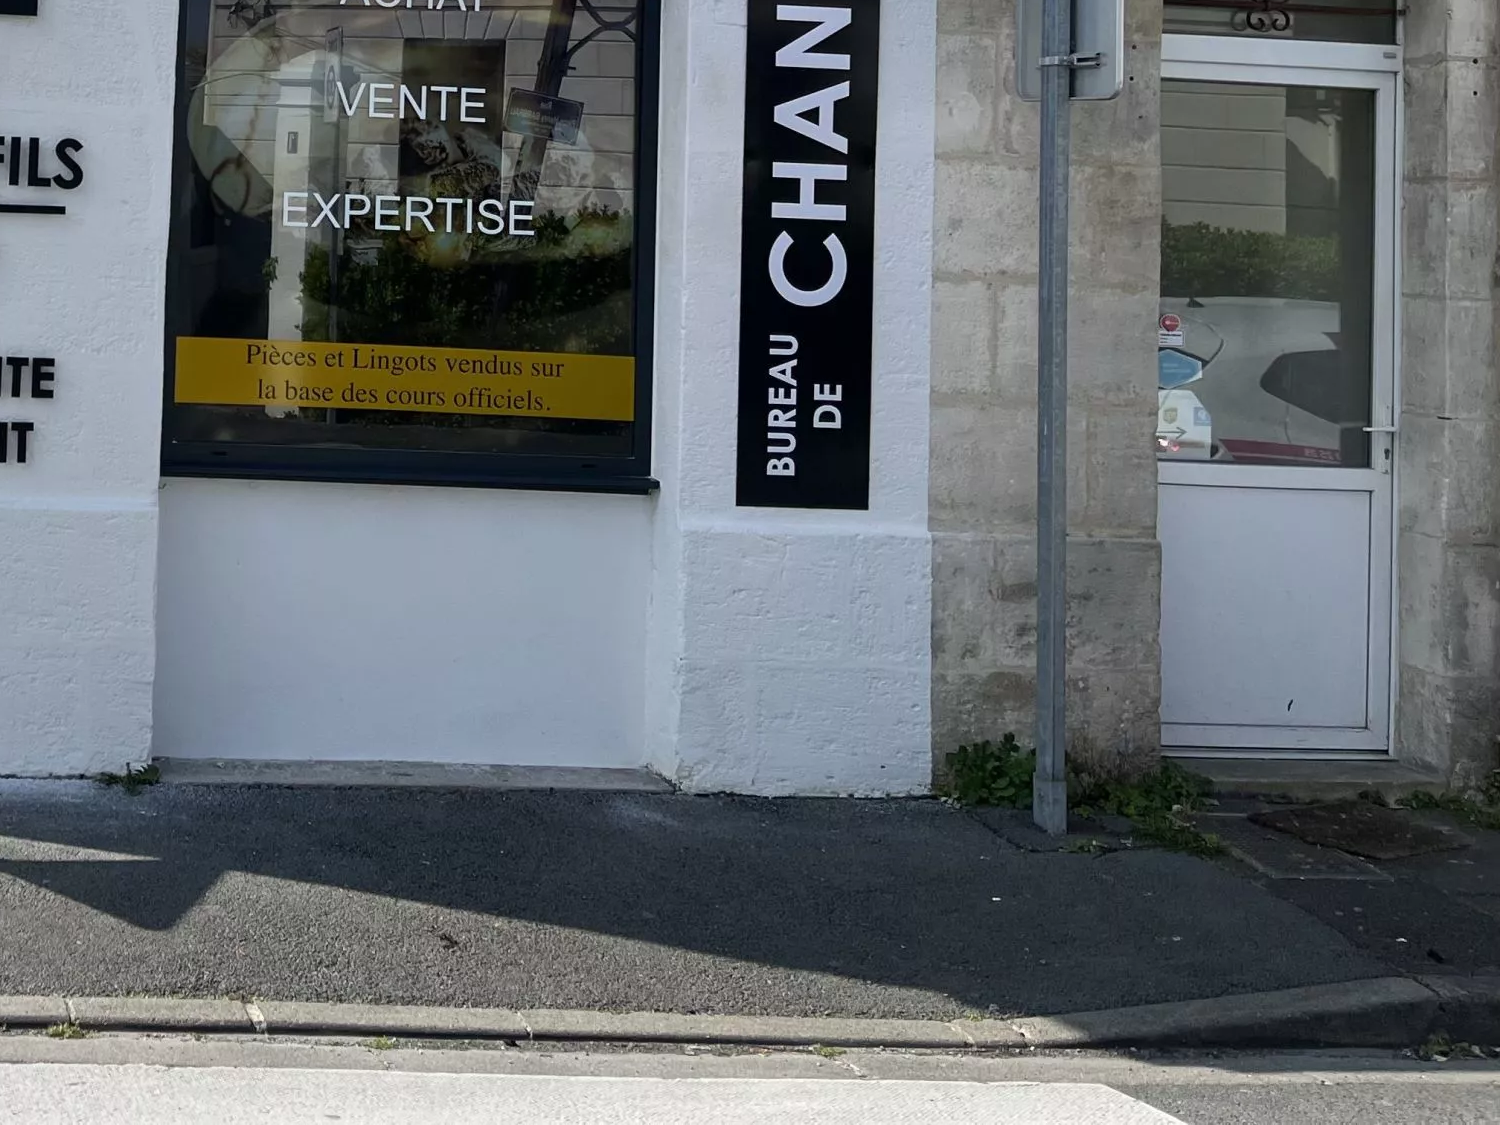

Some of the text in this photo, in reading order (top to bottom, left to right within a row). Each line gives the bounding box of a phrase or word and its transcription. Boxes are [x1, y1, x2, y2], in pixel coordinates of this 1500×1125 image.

[336, 81, 486, 123] VENTE
[281, 191, 536, 236] EXPERTISE
[245, 342, 565, 378] Pièces et Lingots vendus sur
[257, 378, 552, 412] la base des cours officiels.
[766, 334, 799, 477] BUREAU
[813, 383, 842, 429] DE
